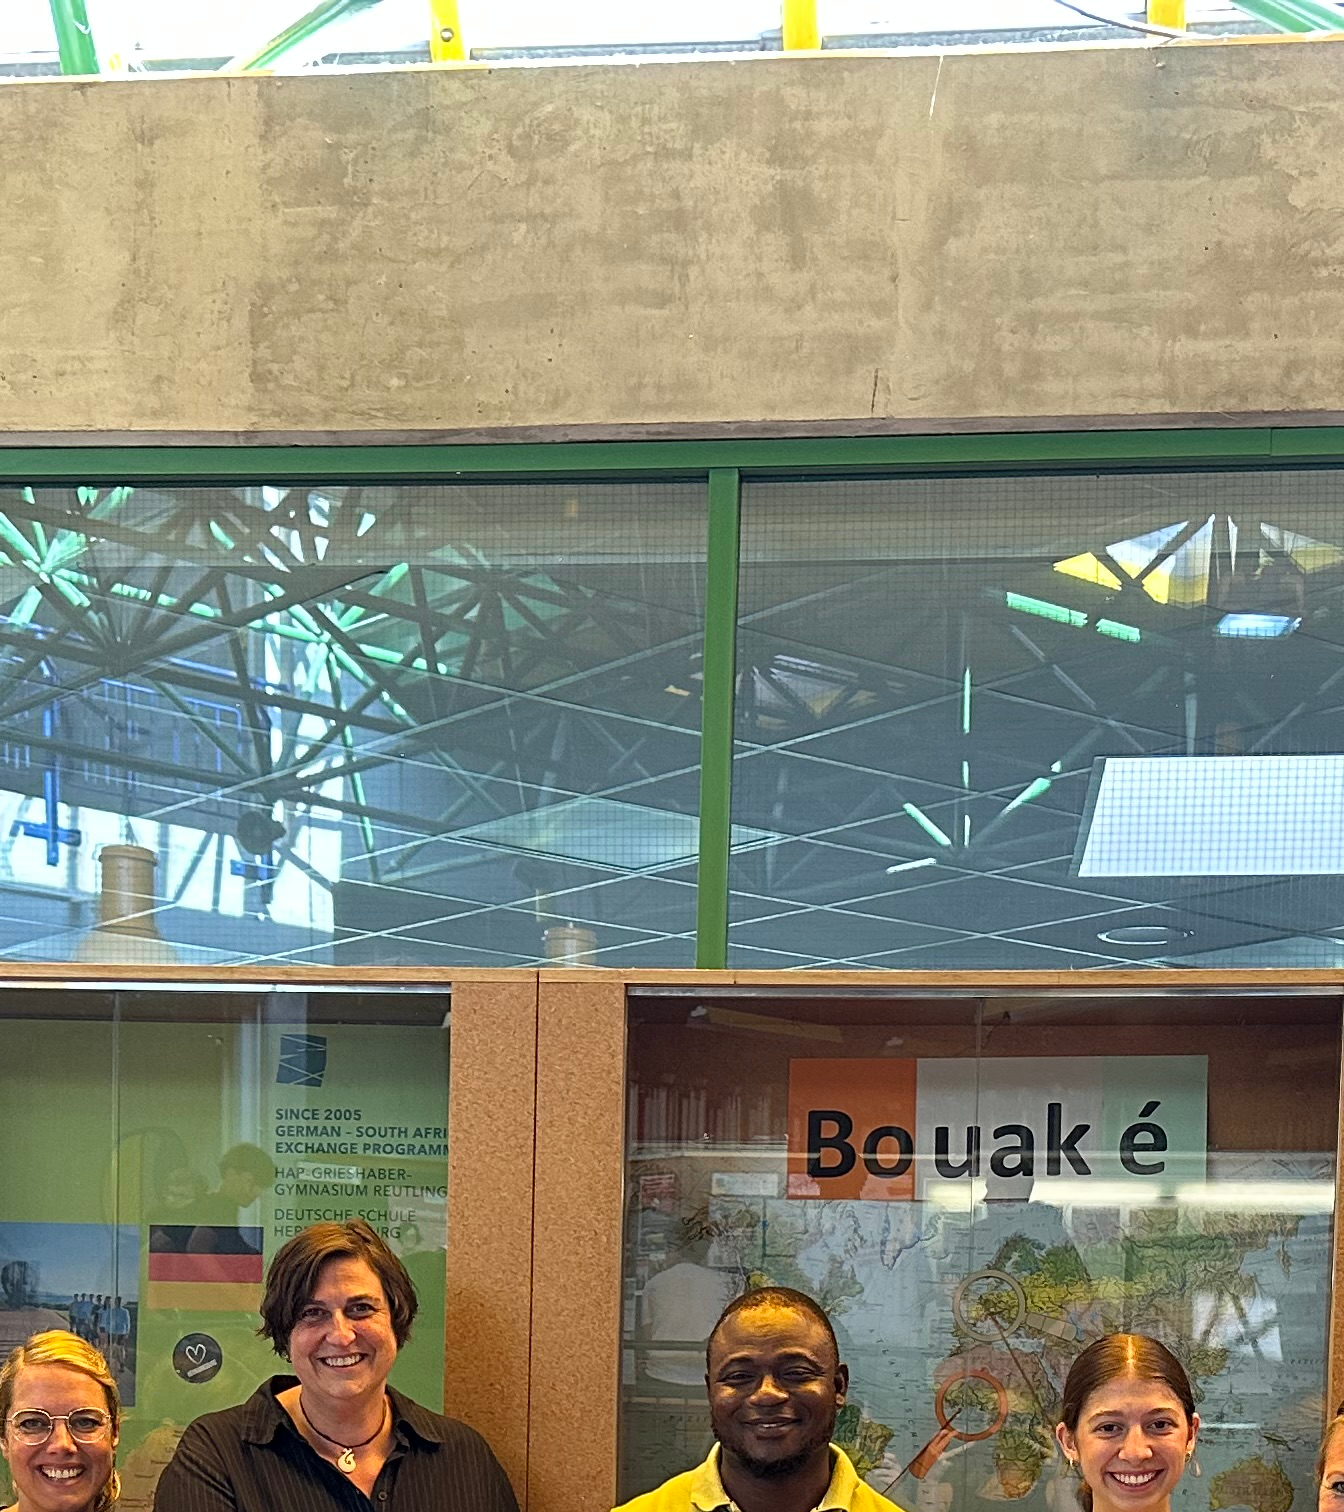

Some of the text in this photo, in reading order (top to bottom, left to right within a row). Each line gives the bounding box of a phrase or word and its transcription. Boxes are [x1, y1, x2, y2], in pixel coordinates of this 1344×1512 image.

[275, 1108, 362, 1121] SINCE 2005
[275, 1125, 341, 1137] GERMAN
[356, 1126, 407, 1138] SOUTH
[806, 1100, 1168, 1178] Bouaké
[275, 1142, 358, 1154] EXCHANGE
[274, 1183, 448, 1198] GYMNASIUM REUTLING
[274, 1208, 417, 1222] DEUTSCHE SCHULE
